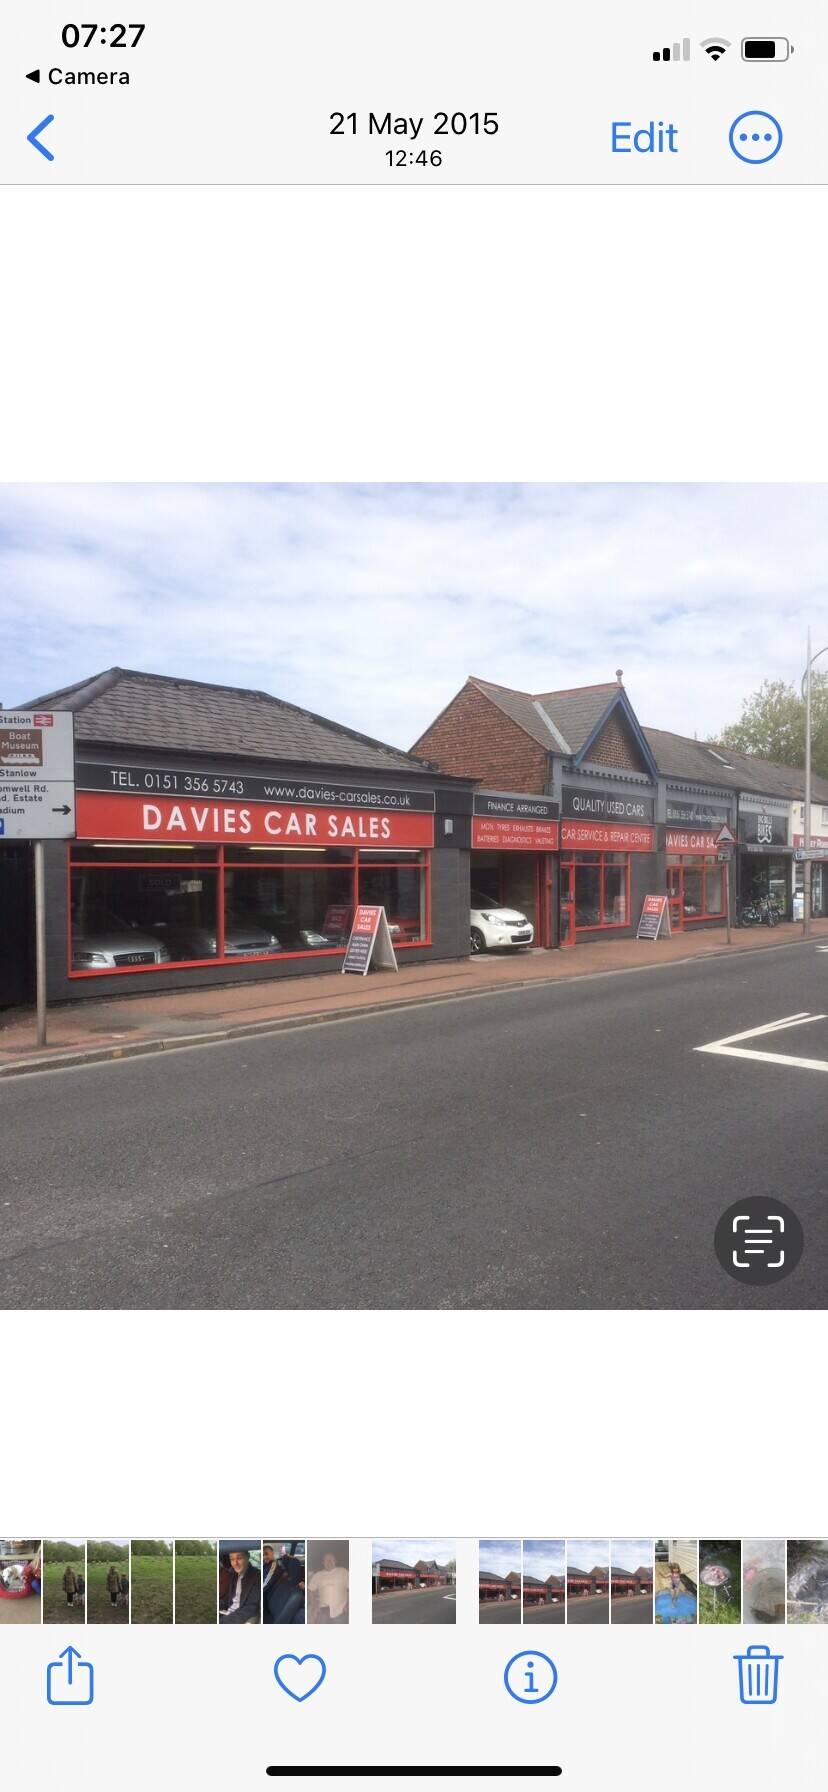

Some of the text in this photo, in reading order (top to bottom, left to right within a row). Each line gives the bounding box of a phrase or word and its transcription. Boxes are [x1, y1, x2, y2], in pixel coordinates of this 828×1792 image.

[9, 732, 31, 740] Boat
[1, 742, 39, 750] Museum
[0, 769, 37, 777] Stanlow
[34, 785, 49, 793] Rd.
[110, 770, 411, 806] TEL. 0151 356 5743 www.davies-carsales.co.uk
[13, 794, 43, 802] Estate
[487, 801, 548, 815] FINANCE ARRANGED
[572, 797, 645, 817] QUALITY USED CARS
[142, 804, 391, 839] DAVIES CAR SALES
[560, 828, 576, 840] CAR
[577, 829, 602, 842] SERVICE
[610, 831, 629, 842] REPAIR
[630, 833, 651, 844] CENTRE
[690, 835, 704, 848] CAR
